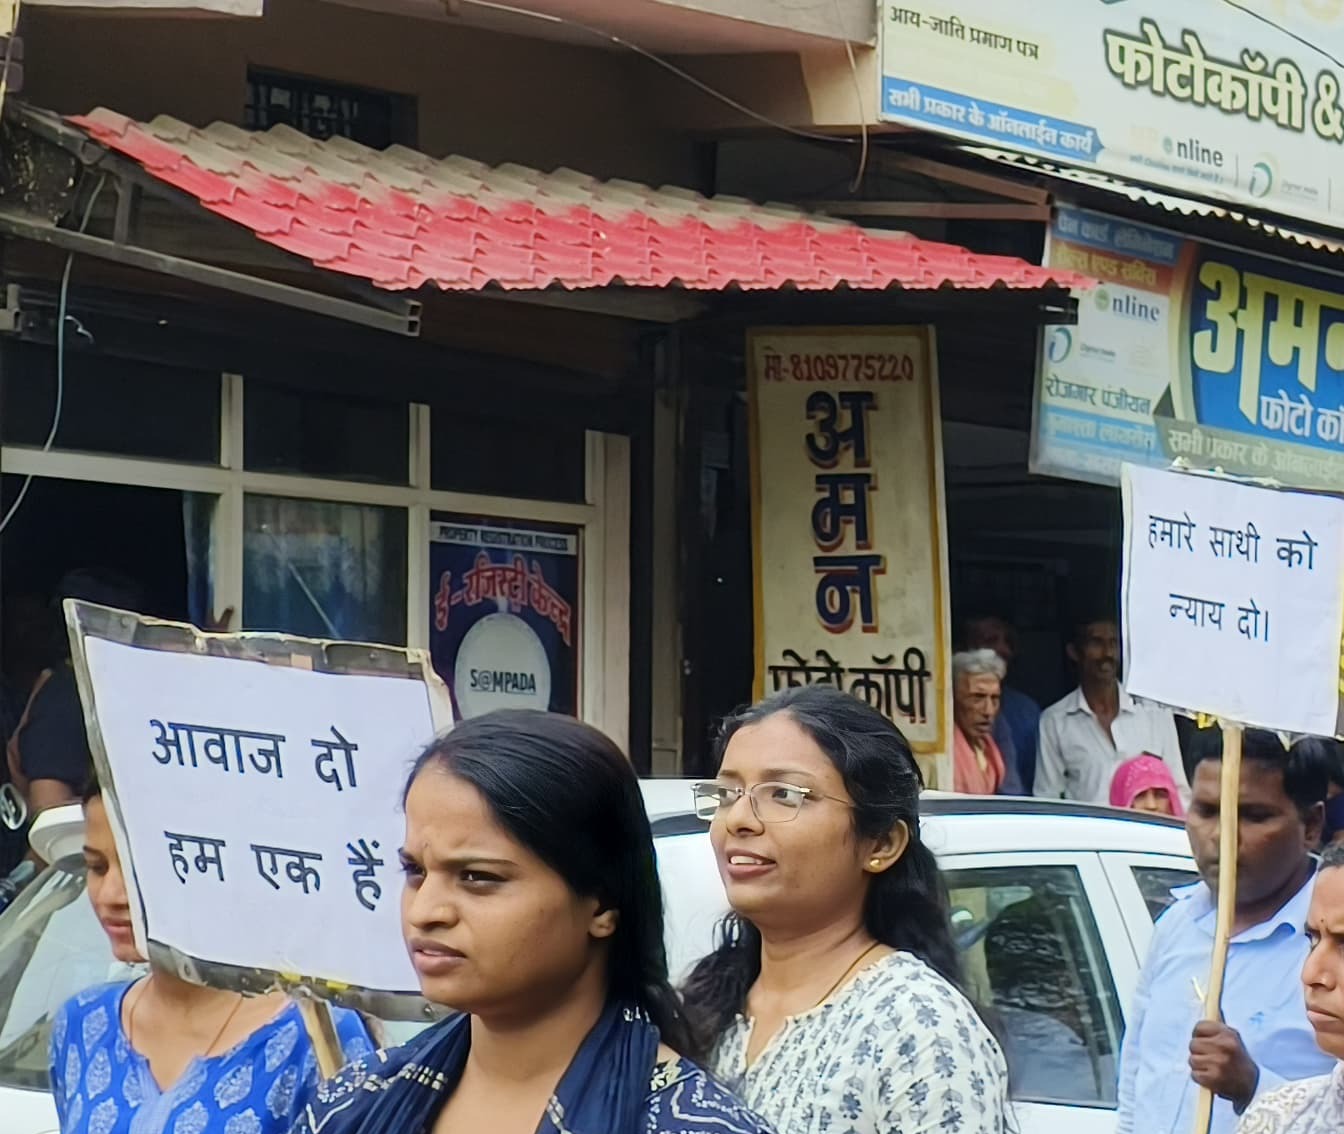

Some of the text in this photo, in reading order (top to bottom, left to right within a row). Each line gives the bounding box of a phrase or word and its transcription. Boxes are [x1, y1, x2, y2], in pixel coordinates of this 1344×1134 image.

[1016, 40, 1040, 61] पत्र
[1103, 17, 1307, 133] फोटोकॉपी
[888, 87, 921, 111] सभी
[923, 96, 965, 123] प्रकार
[967, 101, 985, 127] के
[1260, 389, 1314, 438] फोटो
[1149, 511, 1318, 570] हमारे साथी को
[1169, 593, 1269, 642] न्याय दो।
[470, 669, 537, 692] S@MPADA
[849, 647, 931, 725] कॉपी
[150, 719, 358, 791] आवाज दो
[163, 830, 384, 911] हम एक हैं
